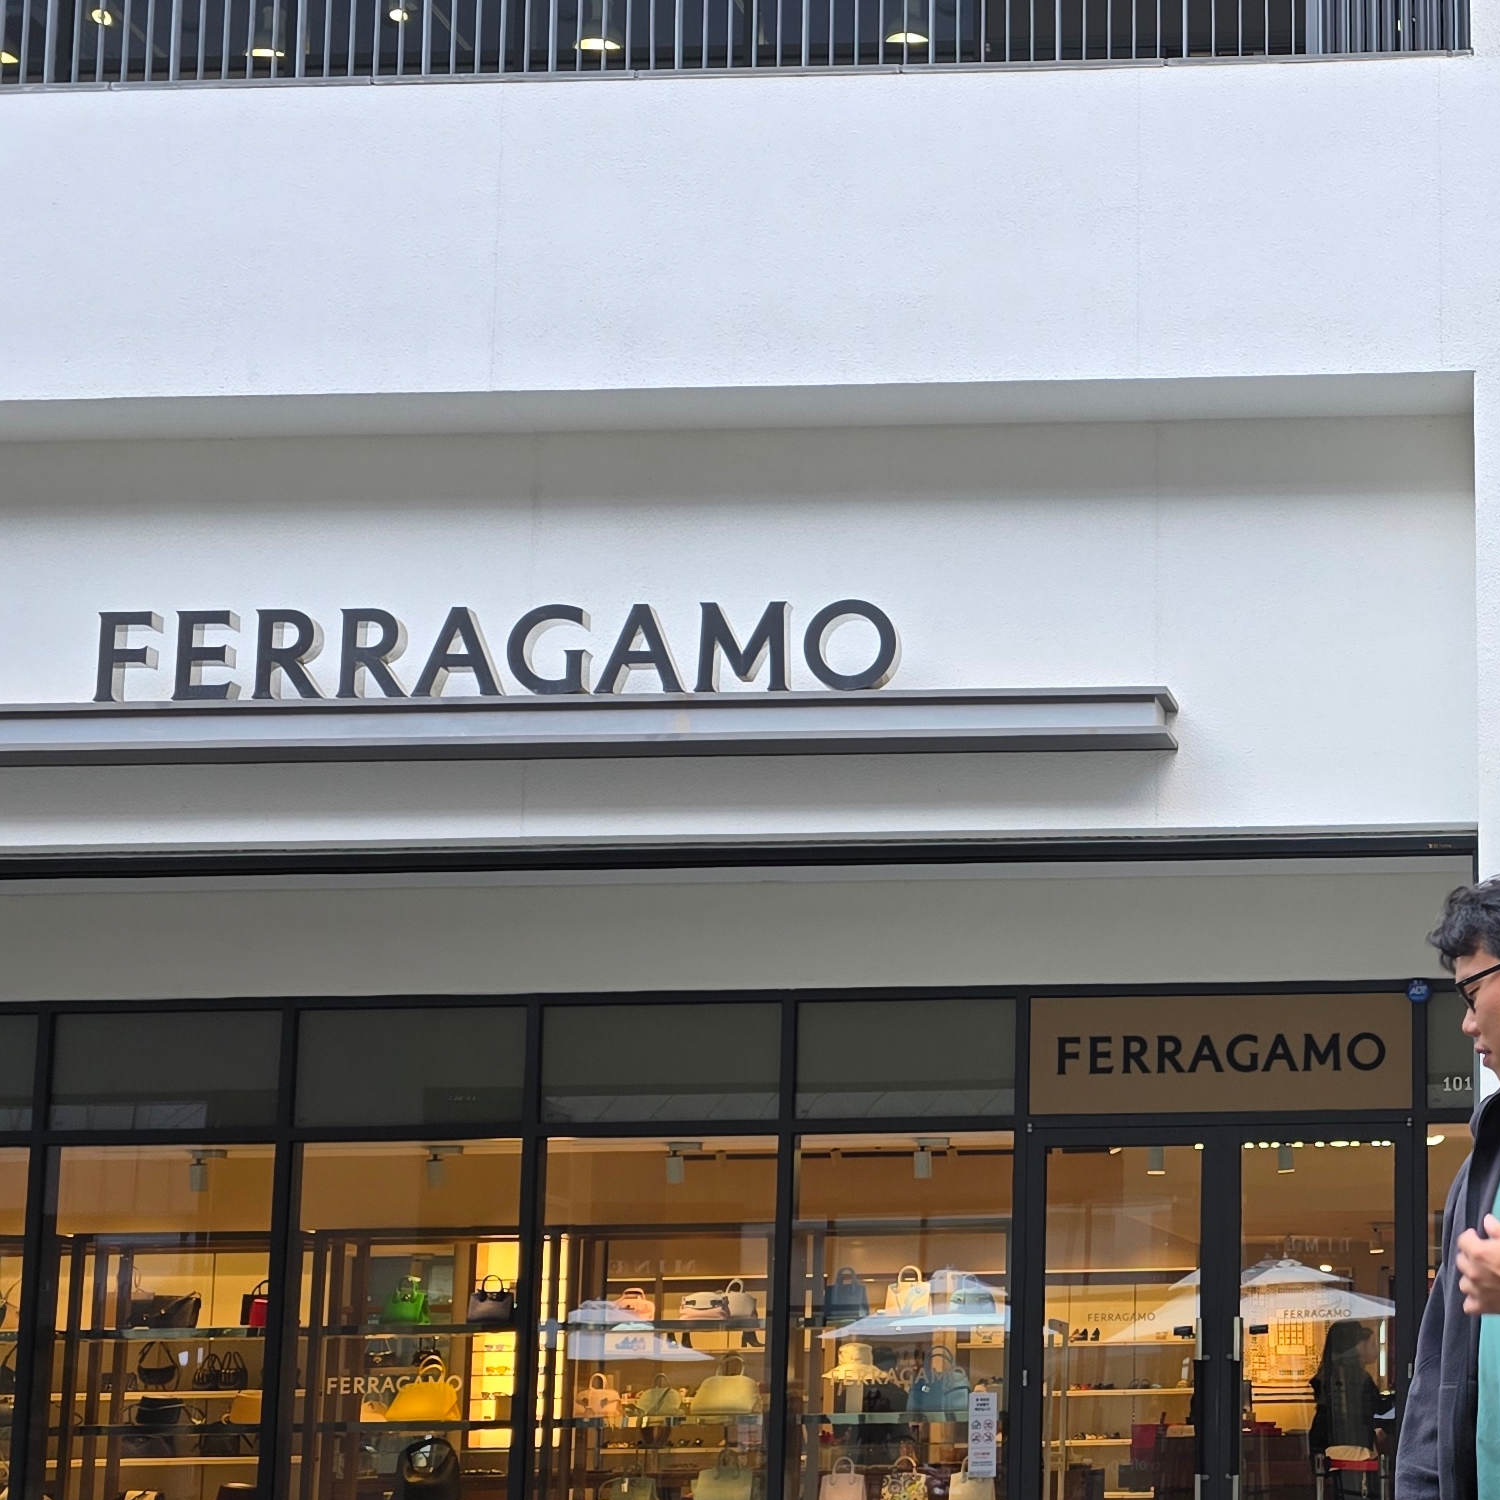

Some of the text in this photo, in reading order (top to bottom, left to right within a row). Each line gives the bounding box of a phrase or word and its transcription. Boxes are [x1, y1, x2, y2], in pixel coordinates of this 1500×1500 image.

[93, 599, 902, 702] FERRAGAMO
[1056, 1032, 1386, 1075] FERRAGAMO
[1443, 1076, 1473, 1092] 101
[1087, 1312, 1156, 1322] FERRAGAMO
[1283, 1308, 1352, 1319] FERRAGAMO
[830, 1366, 967, 1386] FERRAGAMO
